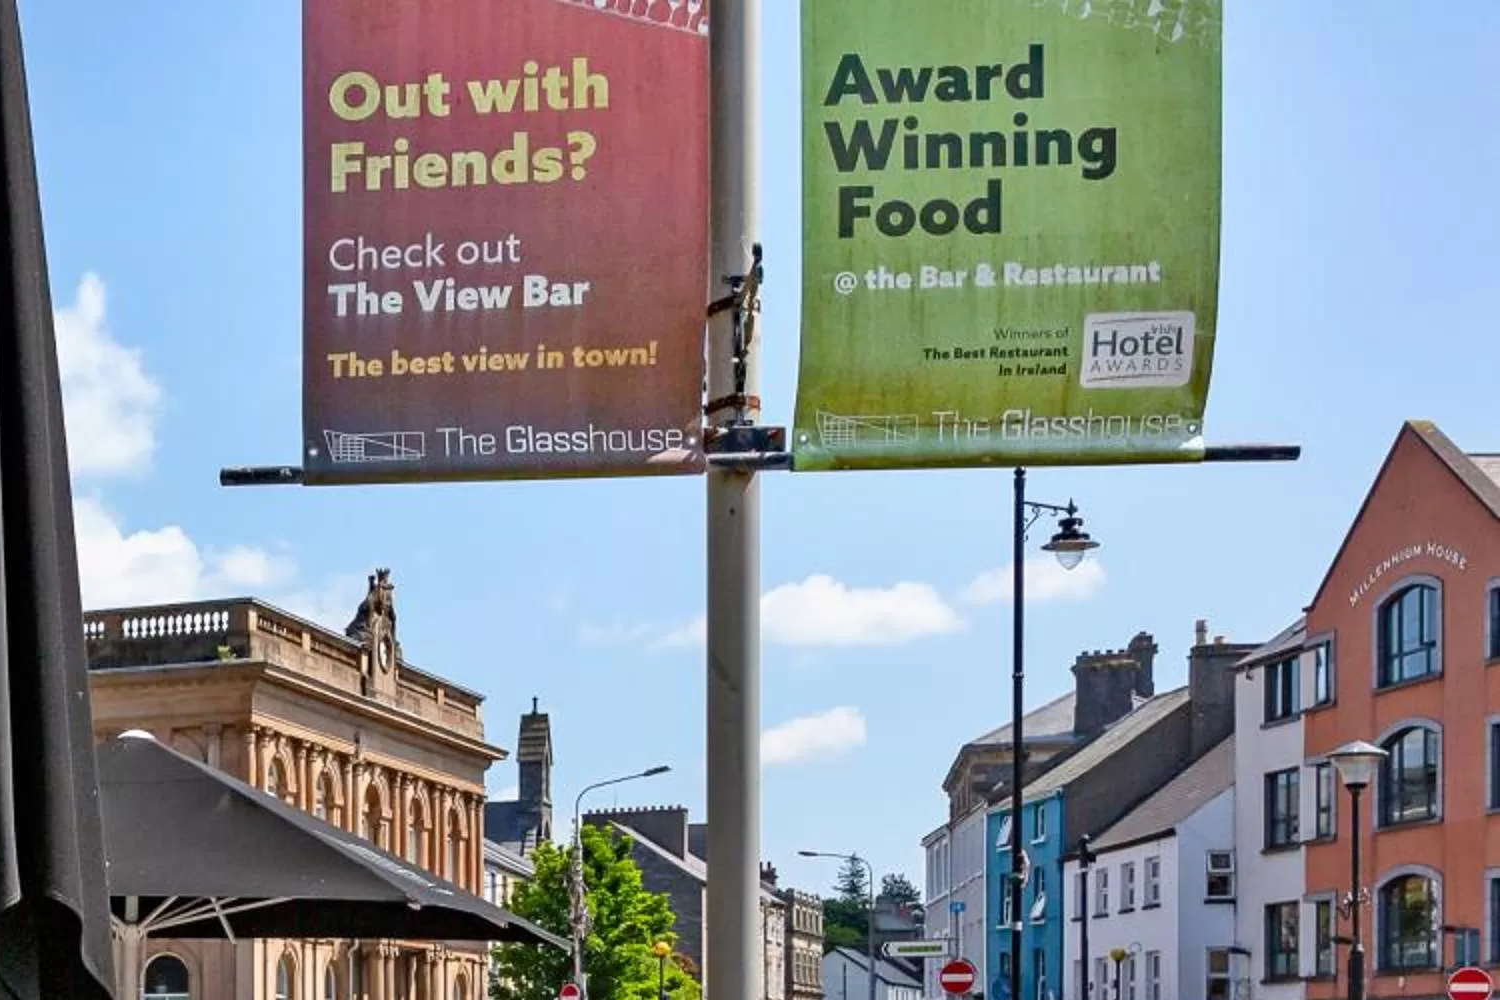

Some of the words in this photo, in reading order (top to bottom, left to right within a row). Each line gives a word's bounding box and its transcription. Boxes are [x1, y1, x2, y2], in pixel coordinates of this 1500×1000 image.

[329, 71, 451, 121] Out
[467, 57, 609, 115] with
[823, 44, 1044, 107] Award
[330, 131, 597, 193] Friends?
[823, 112, 1118, 180] Winning
[837, 178, 1003, 239] Food
[328, 233, 444, 271] Check
[457, 233, 521, 265] out
[834, 272, 857, 294] @
[865, 266, 912, 290] the
[920, 265, 967, 289] Bar
[975, 264, 997, 287] &
[1004, 261, 1161, 287] Restaurant
[327, 282, 403, 317] The
[414, 278, 513, 313] View
[523, 275, 590, 307] Bar
[993, 328, 1052, 341] Winners
[1055, 326, 1070, 339] of
[1092, 326, 1184, 357] Hotel
[327, 352, 384, 379] The
[391, 350, 455, 375] best
[462, 346, 530, 372] view
[537, 344, 564, 369] in
[572, 341, 658, 368] town!
[924, 347, 950, 360] The
[954, 347, 985, 359] Best
[989, 345, 1068, 358] Restaurant
[1016, 364, 1067, 376] Ireland
[1090, 358, 1184, 374] AWARDS
[436, 428, 497, 457] The
[505, 424, 684, 457] Glasshouse
[931, 408, 990, 442] The
[1001, 407, 1182, 441] Glasshouse
[1425, 540, 1468, 570] HOUSE
